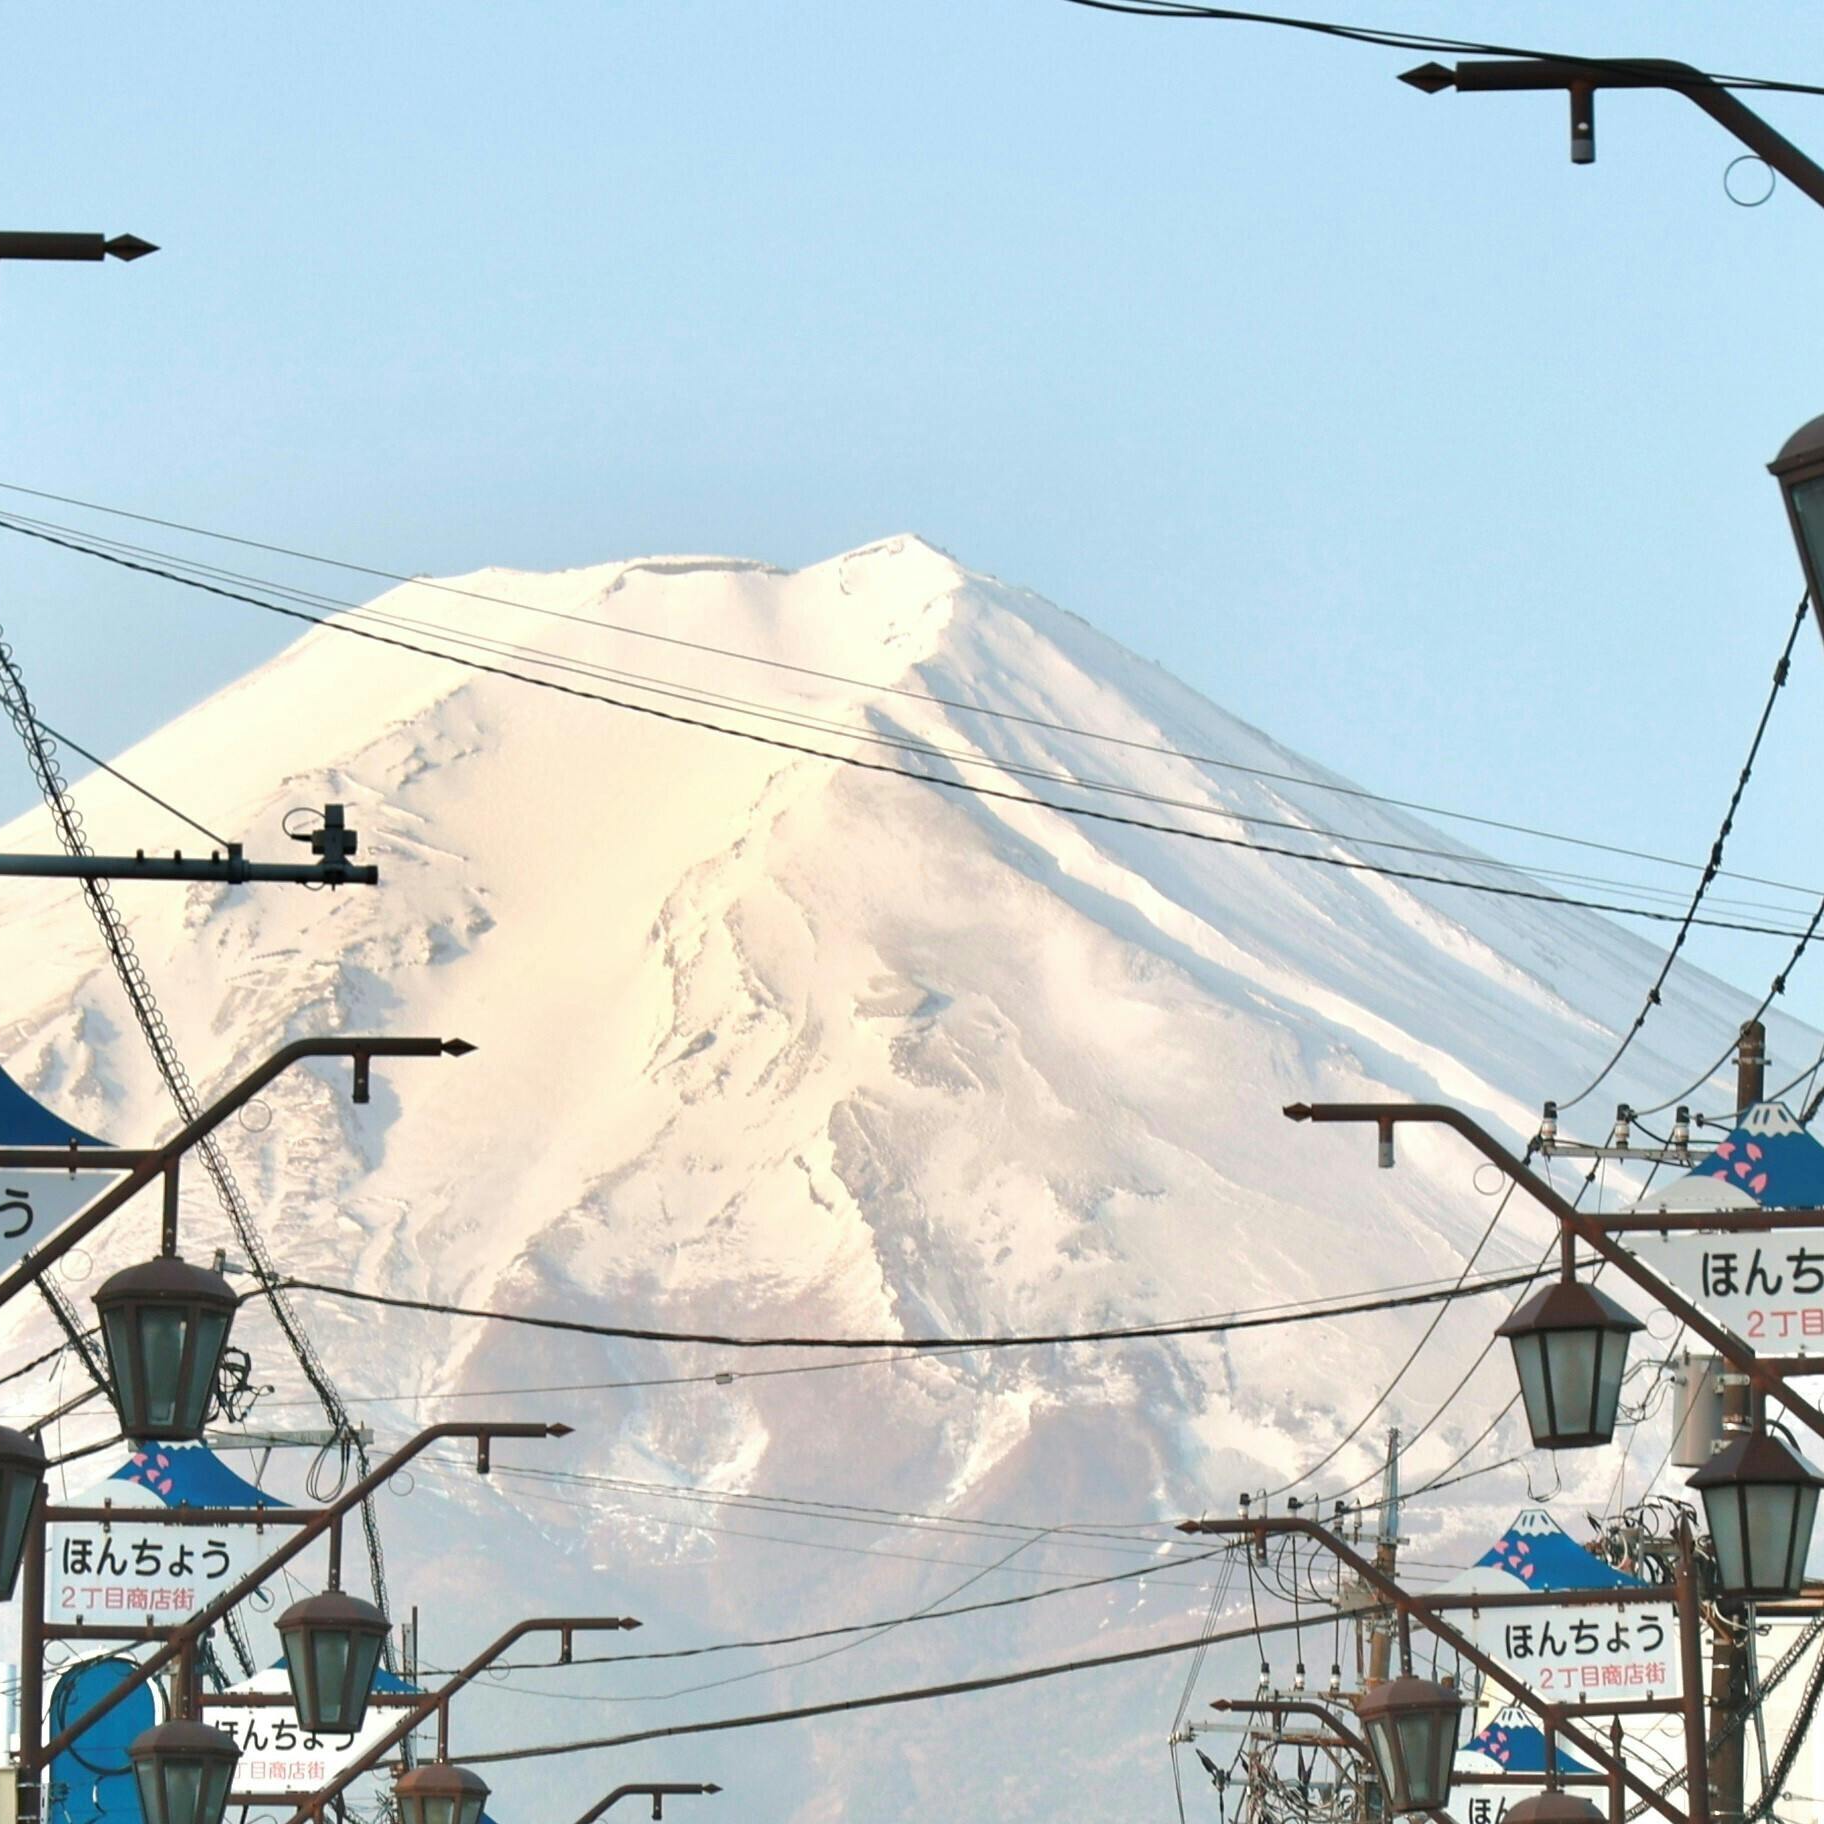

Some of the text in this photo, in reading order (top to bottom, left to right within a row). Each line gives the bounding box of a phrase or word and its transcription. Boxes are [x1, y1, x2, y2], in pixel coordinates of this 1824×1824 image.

[61, 1535, 231, 1579] ほんちょう
[60, 1586, 196, 1612] 2丁目商店街
[1504, 1613, 1666, 1658] ほんちょう
[1538, 1660, 1667, 1690] 2丁目商店街
